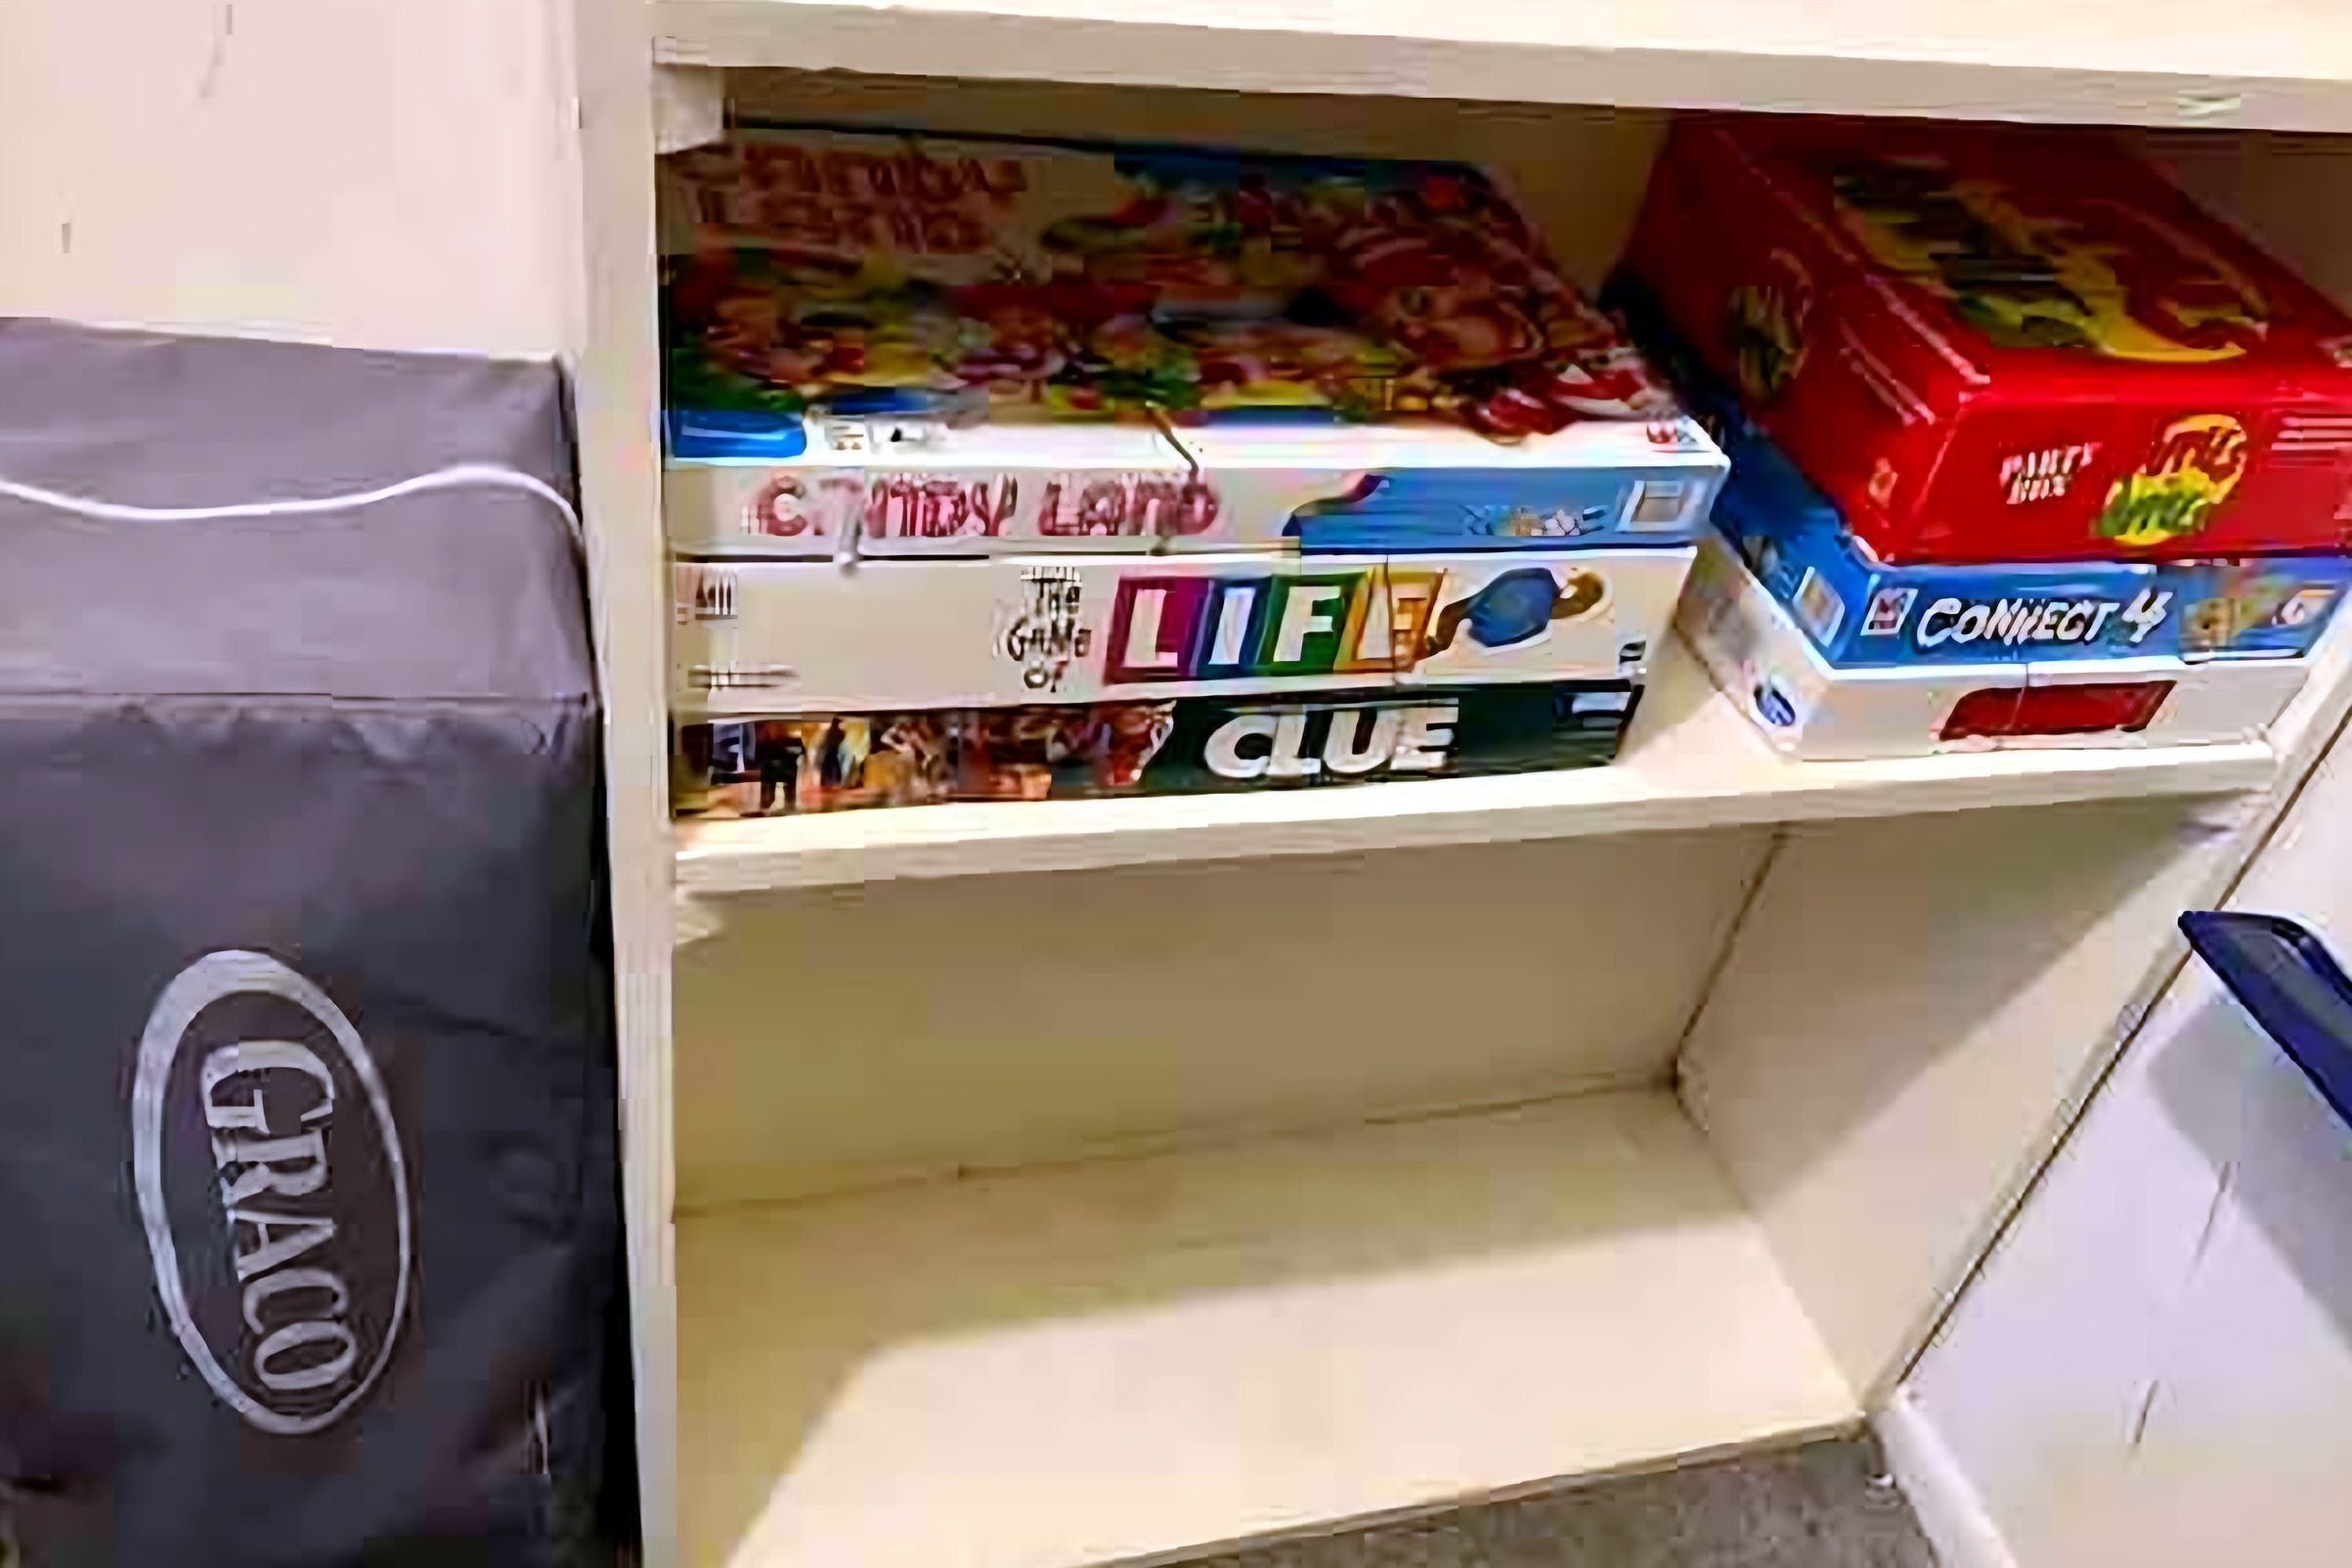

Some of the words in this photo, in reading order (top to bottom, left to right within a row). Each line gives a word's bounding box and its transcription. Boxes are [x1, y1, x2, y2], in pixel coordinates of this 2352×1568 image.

[1120, 582, 1433, 671] LIFE
[1916, 595, 2121, 649] CONNECT
[2120, 587, 2174, 643] 4
[1203, 697, 1459, 778] CLUE
[200, 1039, 358, 1390] GRACO
